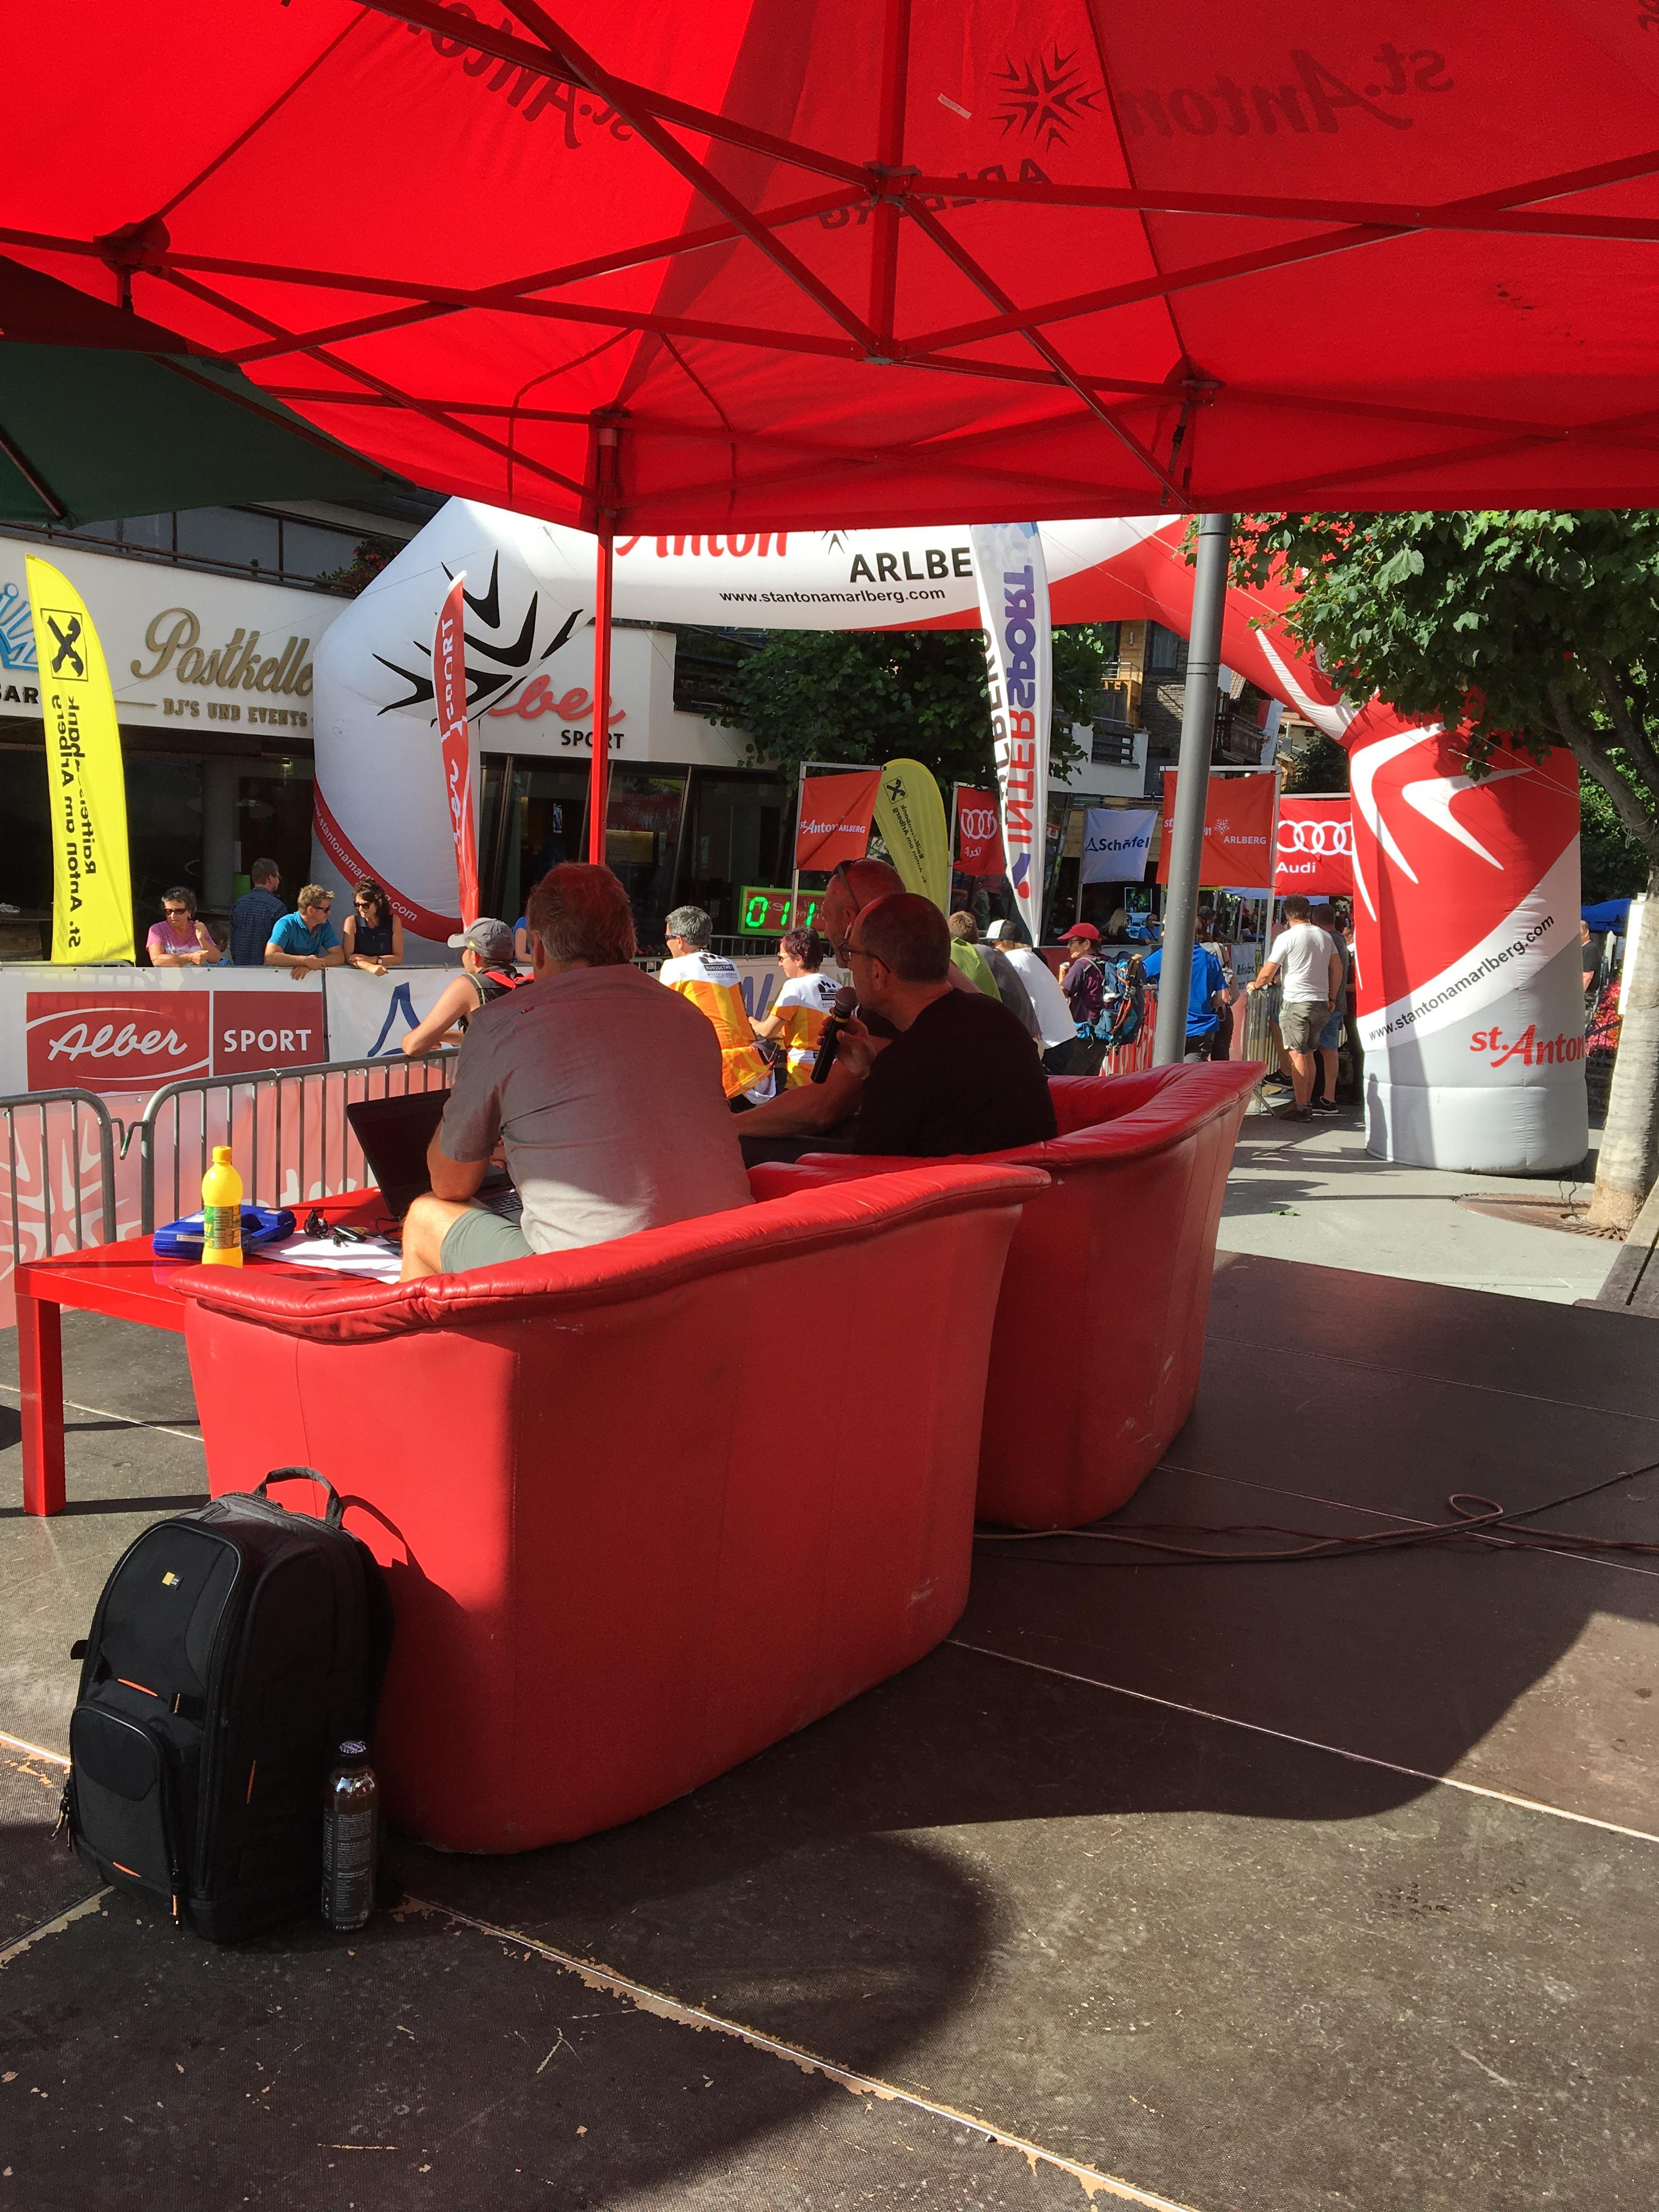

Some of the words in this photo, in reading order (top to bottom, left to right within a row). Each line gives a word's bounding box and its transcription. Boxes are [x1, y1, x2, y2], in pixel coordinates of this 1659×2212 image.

[719, 589, 945, 603] www.stantonamarlberg.com
[207, 702, 241, 721] UND
[247, 707, 308, 726] EVENTS
[838, 824, 866, 834] ARLBERG
[1223, 836, 1267, 845] ARLBERG
[1275, 861, 1316, 873] Audi
[1368, 915, 1555, 1041] www.stantonamarlberg.com
[48, 1023, 188, 1062] Alber
[223, 1029, 312, 1052] SPORT
